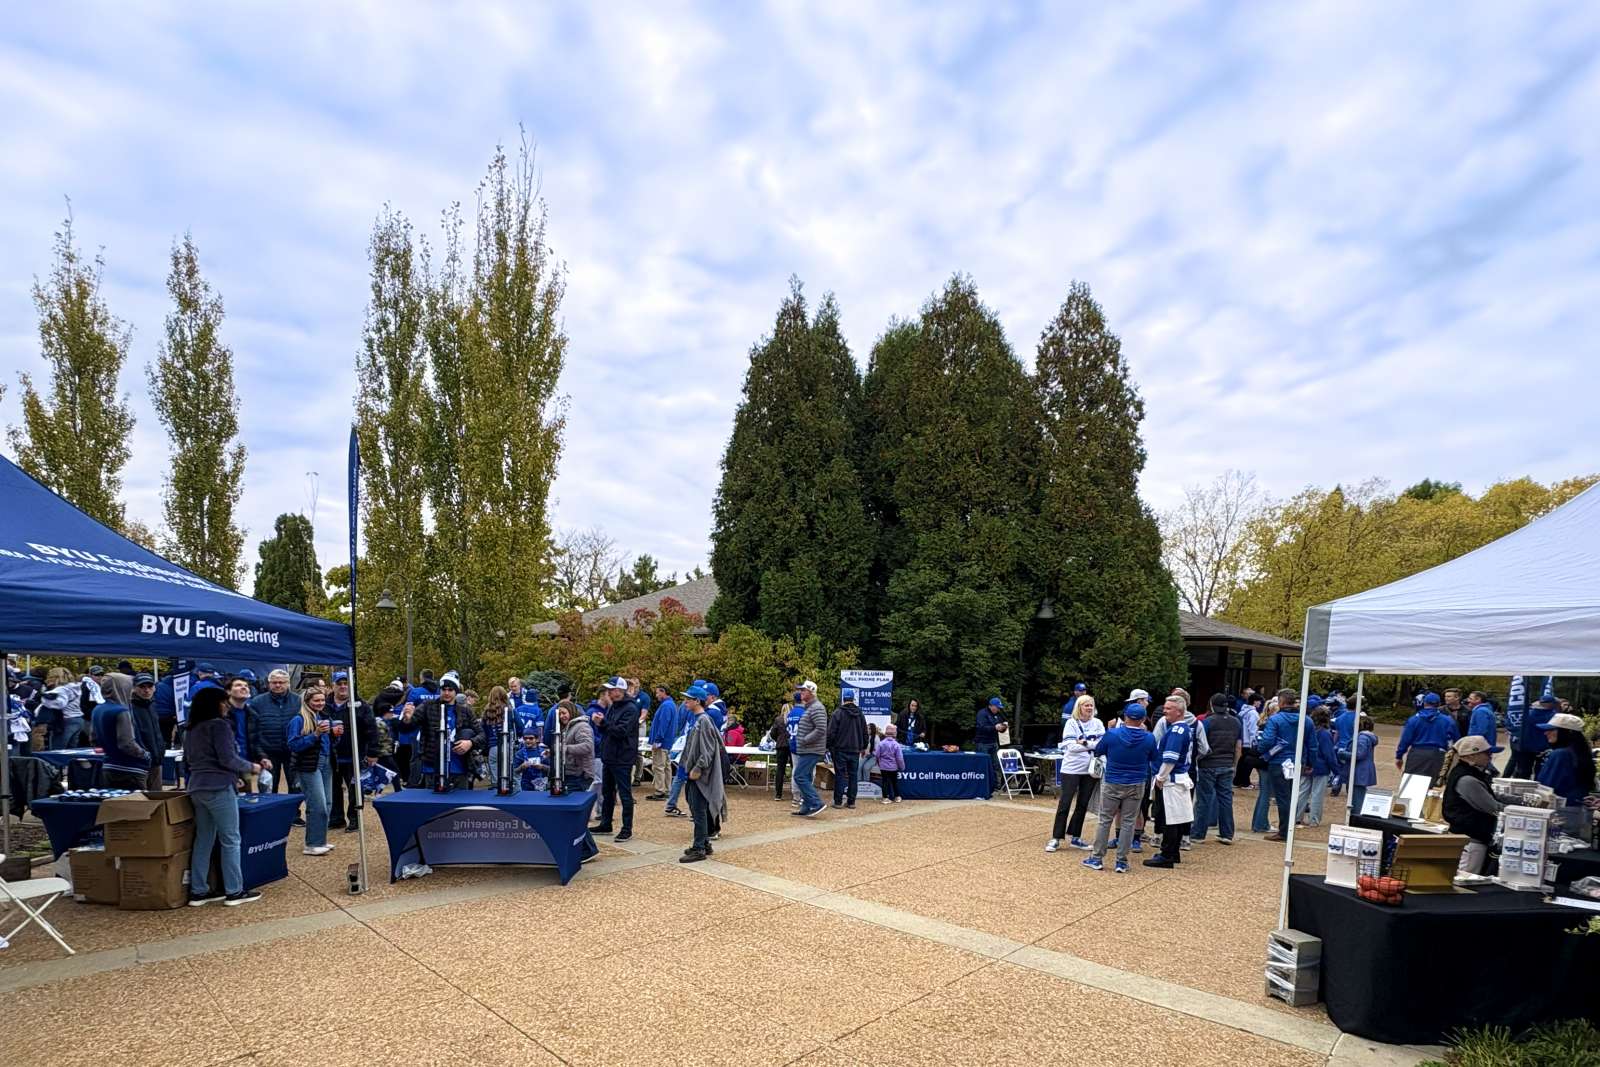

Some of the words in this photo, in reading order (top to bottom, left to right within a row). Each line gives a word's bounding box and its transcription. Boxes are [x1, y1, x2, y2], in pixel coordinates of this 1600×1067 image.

[24, 542, 99, 562] BYU
[140, 614, 190, 637] BYU
[196, 620, 280, 648] Engineering
[918, 771, 934, 780] Cell
[935, 771, 960, 780] Phone
[961, 771, 985, 780] Office
